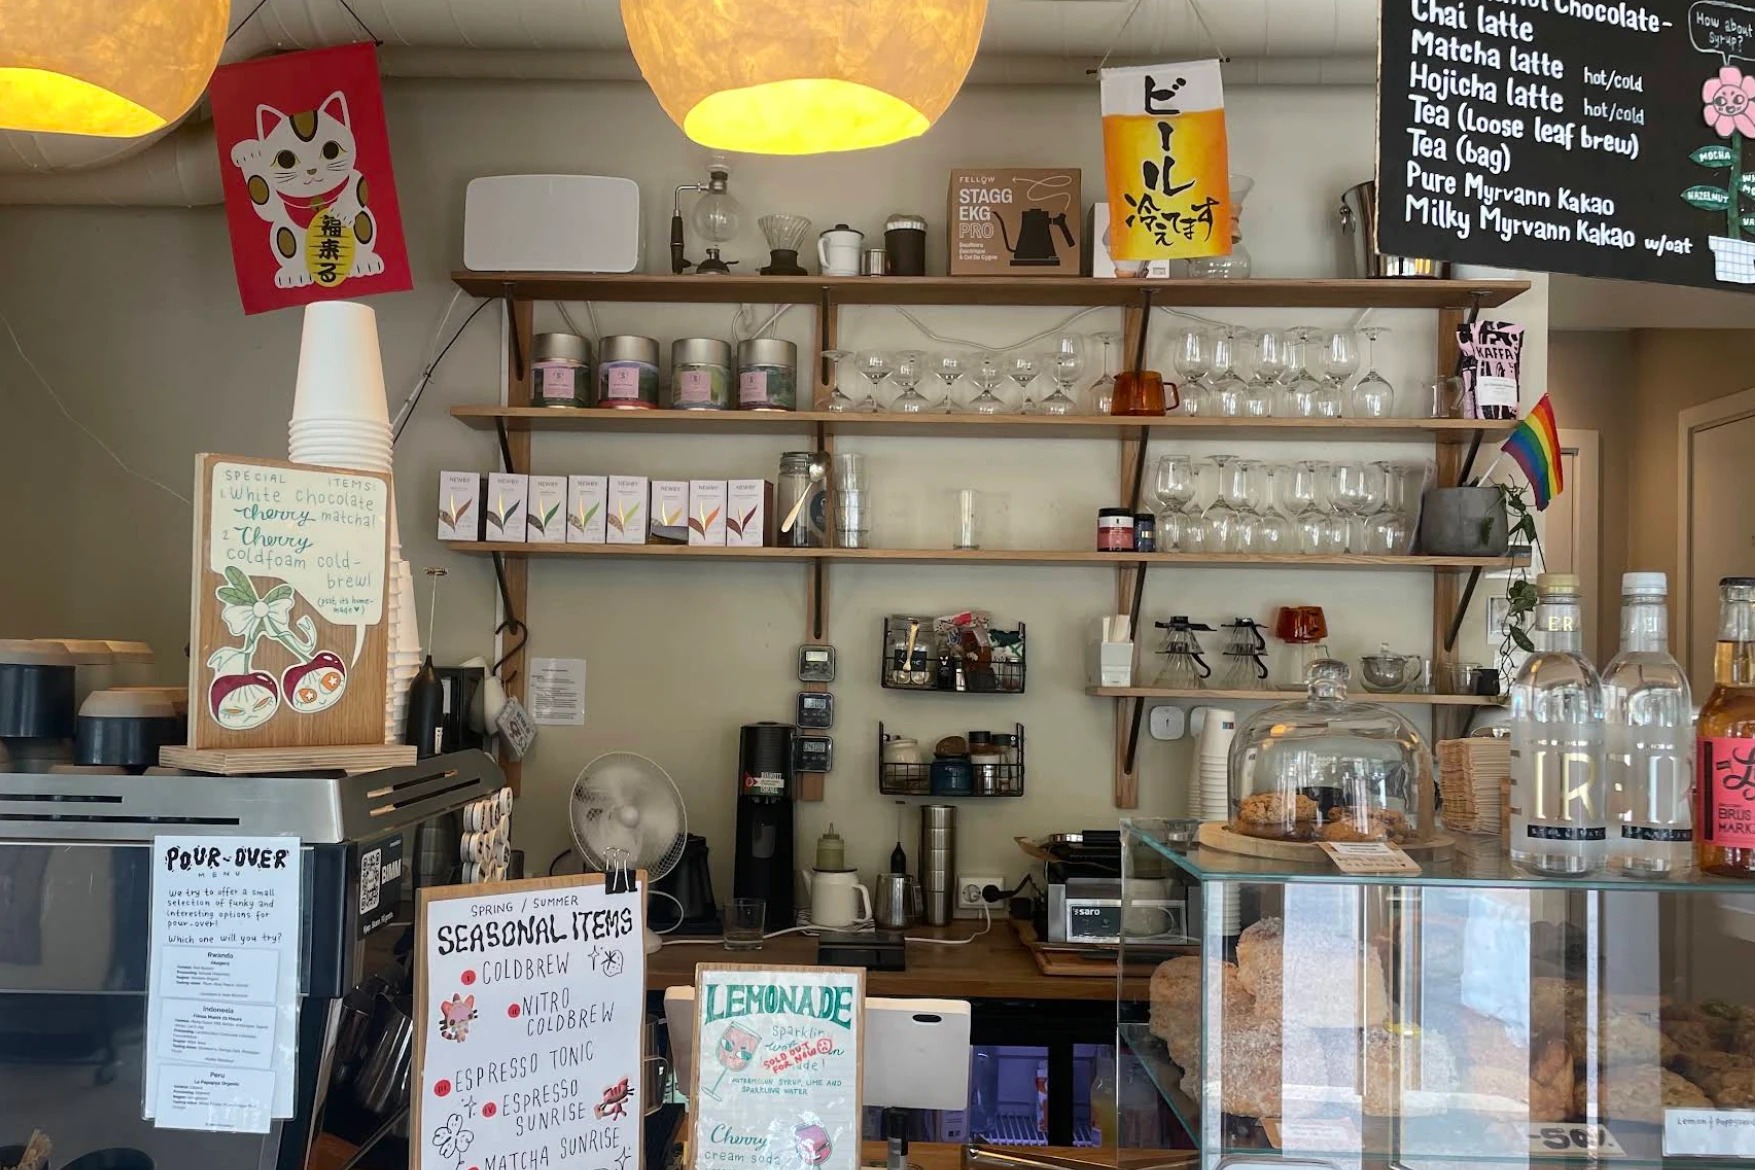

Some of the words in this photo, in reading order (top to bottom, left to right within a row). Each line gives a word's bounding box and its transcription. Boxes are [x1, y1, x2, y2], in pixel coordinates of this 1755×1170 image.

[1411, 0, 1468, 29] Chai
[1478, 5, 1534, 42] latte
[1696, 11, 1720, 28] How
[1724, 18, 1753, 38] about
[1709, 31, 1744, 53] Syrup?
[1411, 28, 1501, 70] Matcha
[1510, 46, 1564, 79] latte
[1584, 66, 1643, 92] hot/cold
[1410, 61, 1498, 104] Hojicha
[1506, 77, 1564, 113] latte
[1584, 98, 1645, 126] hot/cold
[1142, 75, 1196, 197] ビール
[1408, 94, 1450, 129] Tea
[1457, 102, 1525, 138] (Loose
[1535, 116, 1576, 150] leaf
[1581, 125, 1640, 160] brew)
[1406, 127, 1448, 161] Tea
[1456, 134, 1511, 174] (bag)
[1699, 150, 1731, 163] MOCHA
[959, 176, 996, 184] FELLOW
[1407, 160, 1457, 195] Pure
[1464, 172, 1551, 206] Myrvann
[1558, 187, 1615, 216] Kakao
[959, 188, 1013, 204] STAGG
[1687, 190, 1729, 203] HAZELNUT
[959, 206, 991, 221] EKG
[1124, 193, 1220, 246] 冷えてます
[958, 222, 995, 239] PRO
[1405, 194, 1471, 239] Milky
[1480, 204, 1571, 242] Myrvann
[1576, 219, 1636, 249] Kakao
[1644, 234, 1694, 257] w/oat
[1475, 346, 1514, 360] KAFFA
[225, 469, 287, 484] SPECIAL
[230, 486, 281, 503] White
[321, 510, 376, 528] matcha!
[226, 548, 306, 570] coldfoam
[317, 551, 362, 569] cold-
[1718, 807, 1752, 821] BRUS
[165, 846, 288, 871] POUR-OVER
[167, 898, 210, 907] selection
[215, 898, 224, 906] of
[228, 898, 254, 909] funky
[258, 899, 274, 908] and
[168, 889, 182, 897] We
[186, 888, 201, 899] try
[204, 887, 214, 895] to
[217, 886, 238, 896] offer
[242, 888, 247, 896] a
[252, 888, 275, 896] small
[167, 909, 214, 919] interesting
[218, 910, 251, 919] options
[256, 910, 269, 921] for
[471, 902, 514, 917] SPRING
[533, 895, 579, 908] SUMMER
[1079, 908, 1100, 916] saro
[168, 933, 195, 943] Which
[219, 933, 236, 942] will
[240, 934, 257, 945] you
[262, 932, 282, 943] try?
[438, 914, 568, 956] SEASONAL
[572, 907, 633, 942] ITEMS
[207, 951, 234, 959] Rwanda
[482, 951, 570, 985] COLDBREW
[202, 1006, 234, 1014] Indonesia
[522, 987, 570, 1016] NITRO
[704, 984, 853, 1030] LEMONADE
[527, 1001, 615, 1037] COLDBREW
[455, 1052, 538, 1093] ESPRESSO
[549, 1040, 594, 1070] TONIC
[763, 1052, 788, 1070] SOLD
[789, 1041, 811, 1057] OUT
[772, 1060, 793, 1074] FOR
[794, 1047, 818, 1064] NOW
[209, 1071, 226, 1079] Peru
[502, 1079, 579, 1117] ESPRESSO
[516, 1102, 586, 1137] SUNRISE
[485, 1146, 550, 1170] MATCHA
[560, 1127, 620, 1160] SUNRISE
[710, 1123, 768, 1151] Cherry
[704, 1151, 744, 1162] cream
[751, 1152, 780, 1165] soda
